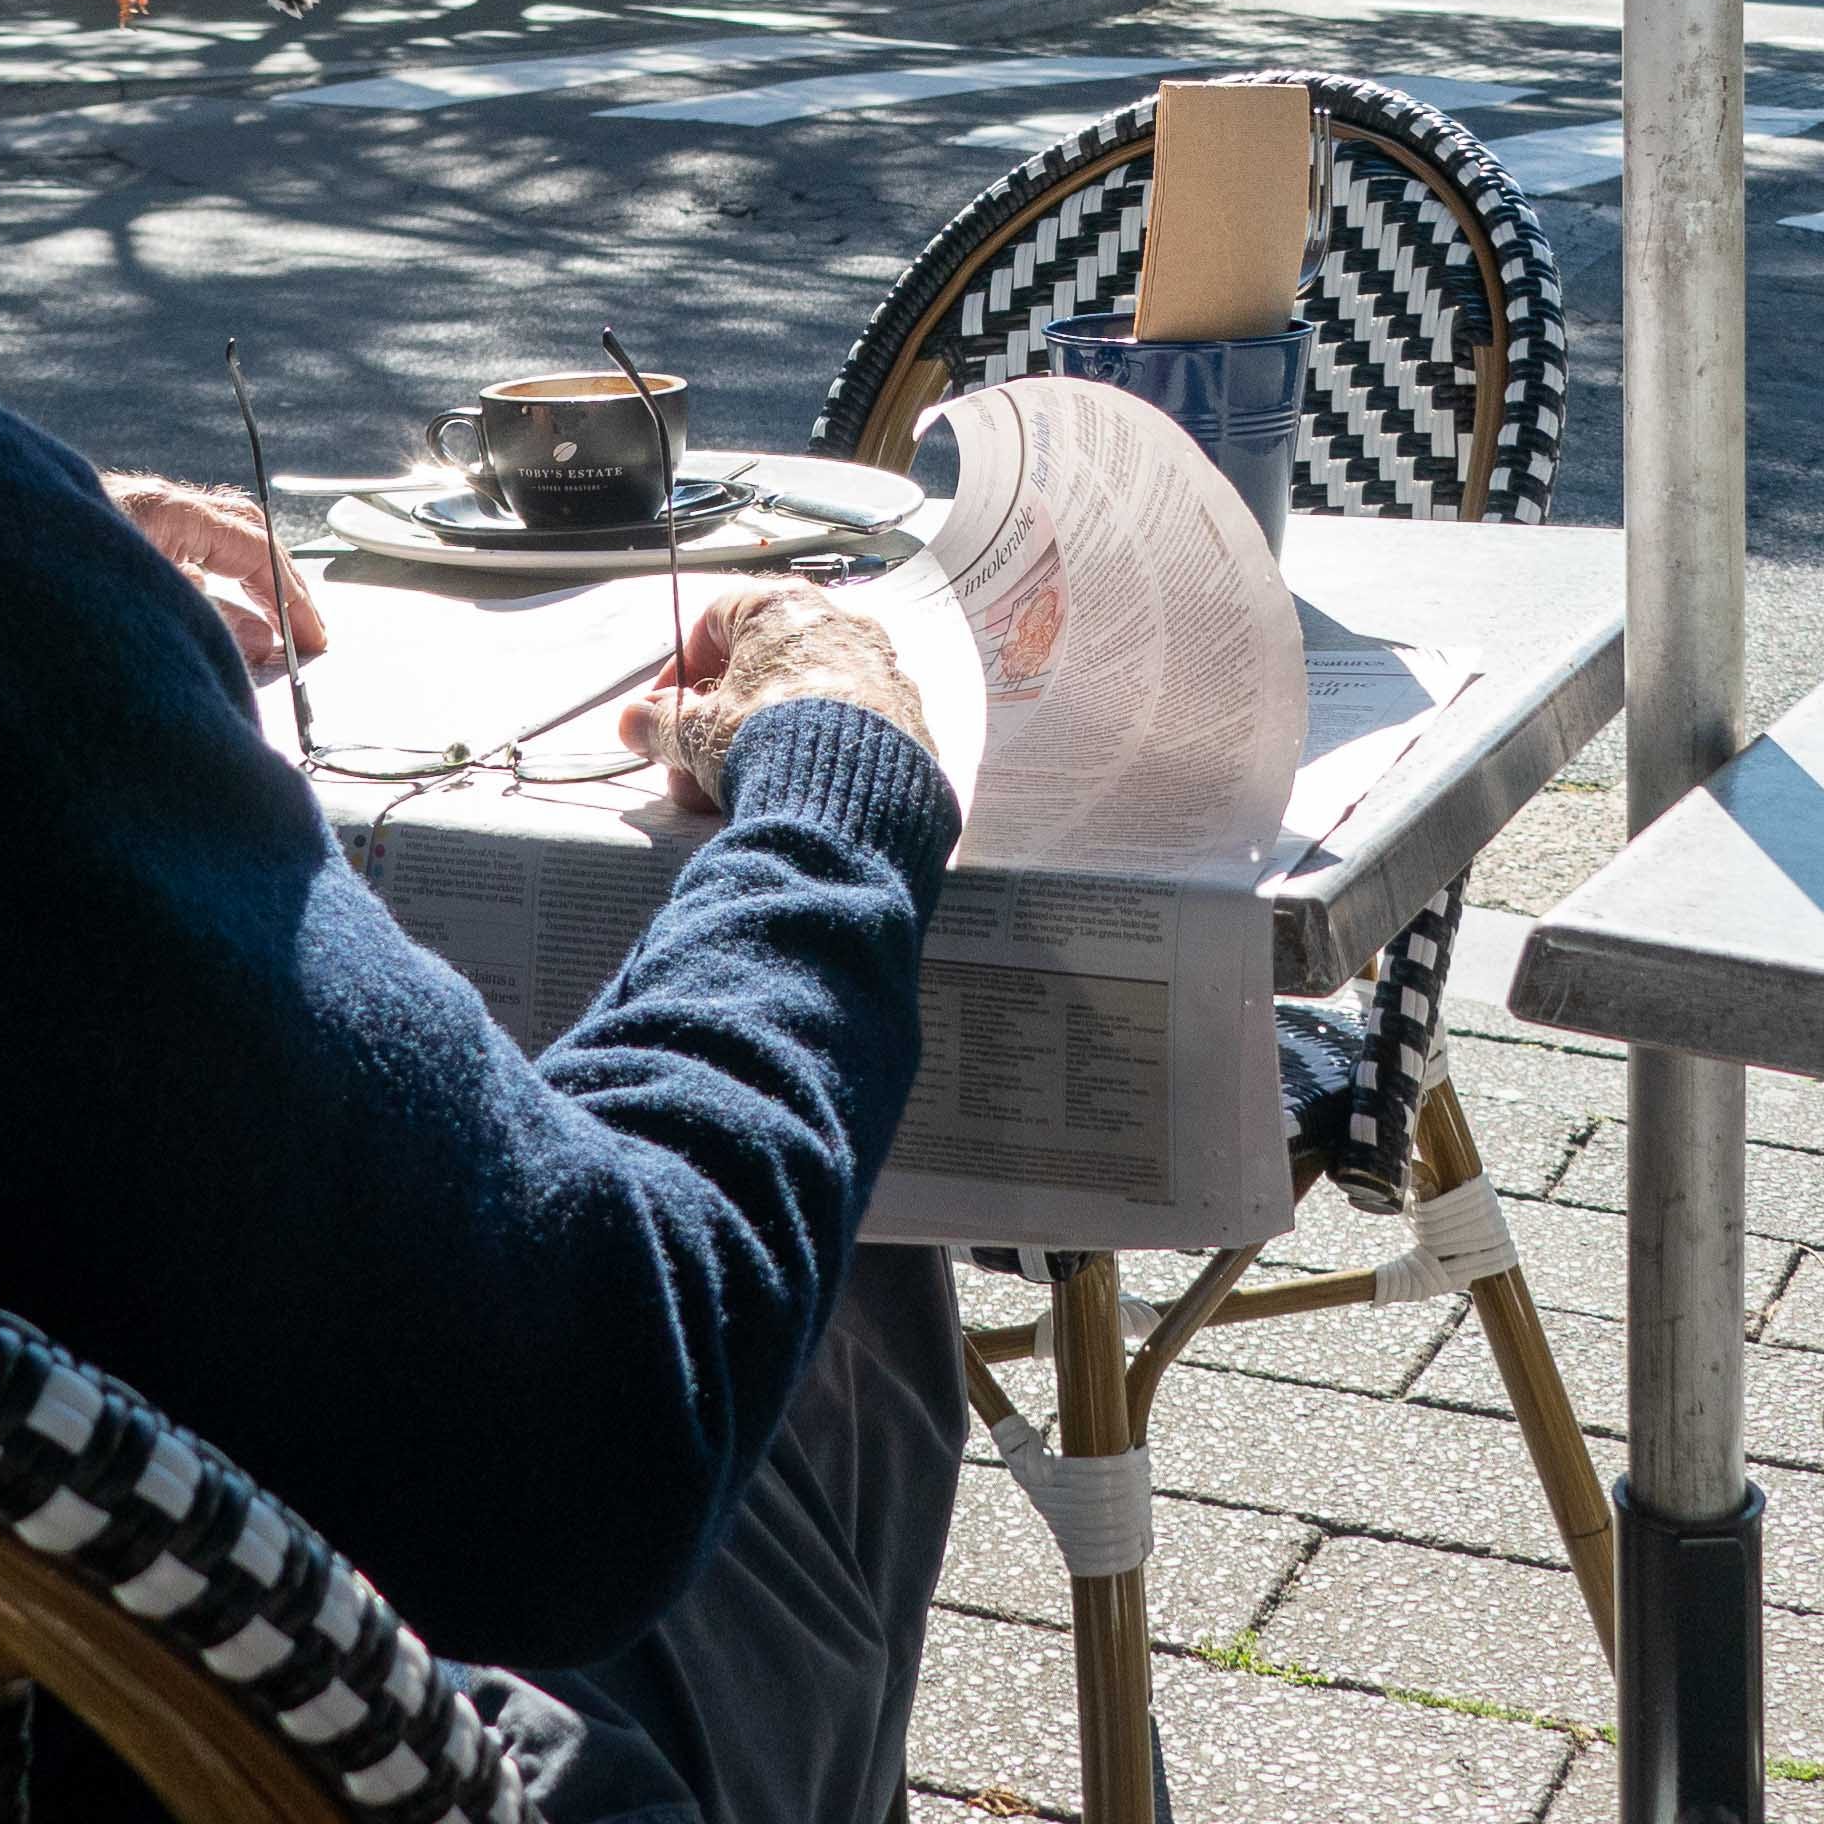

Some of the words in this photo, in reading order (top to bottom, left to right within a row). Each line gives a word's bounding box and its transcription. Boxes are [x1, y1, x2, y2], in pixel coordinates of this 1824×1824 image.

[517, 467, 563, 479] TOBY'S
[567, 466, 623, 479] ESTATE
[964, 502, 1036, 598] intolerable
